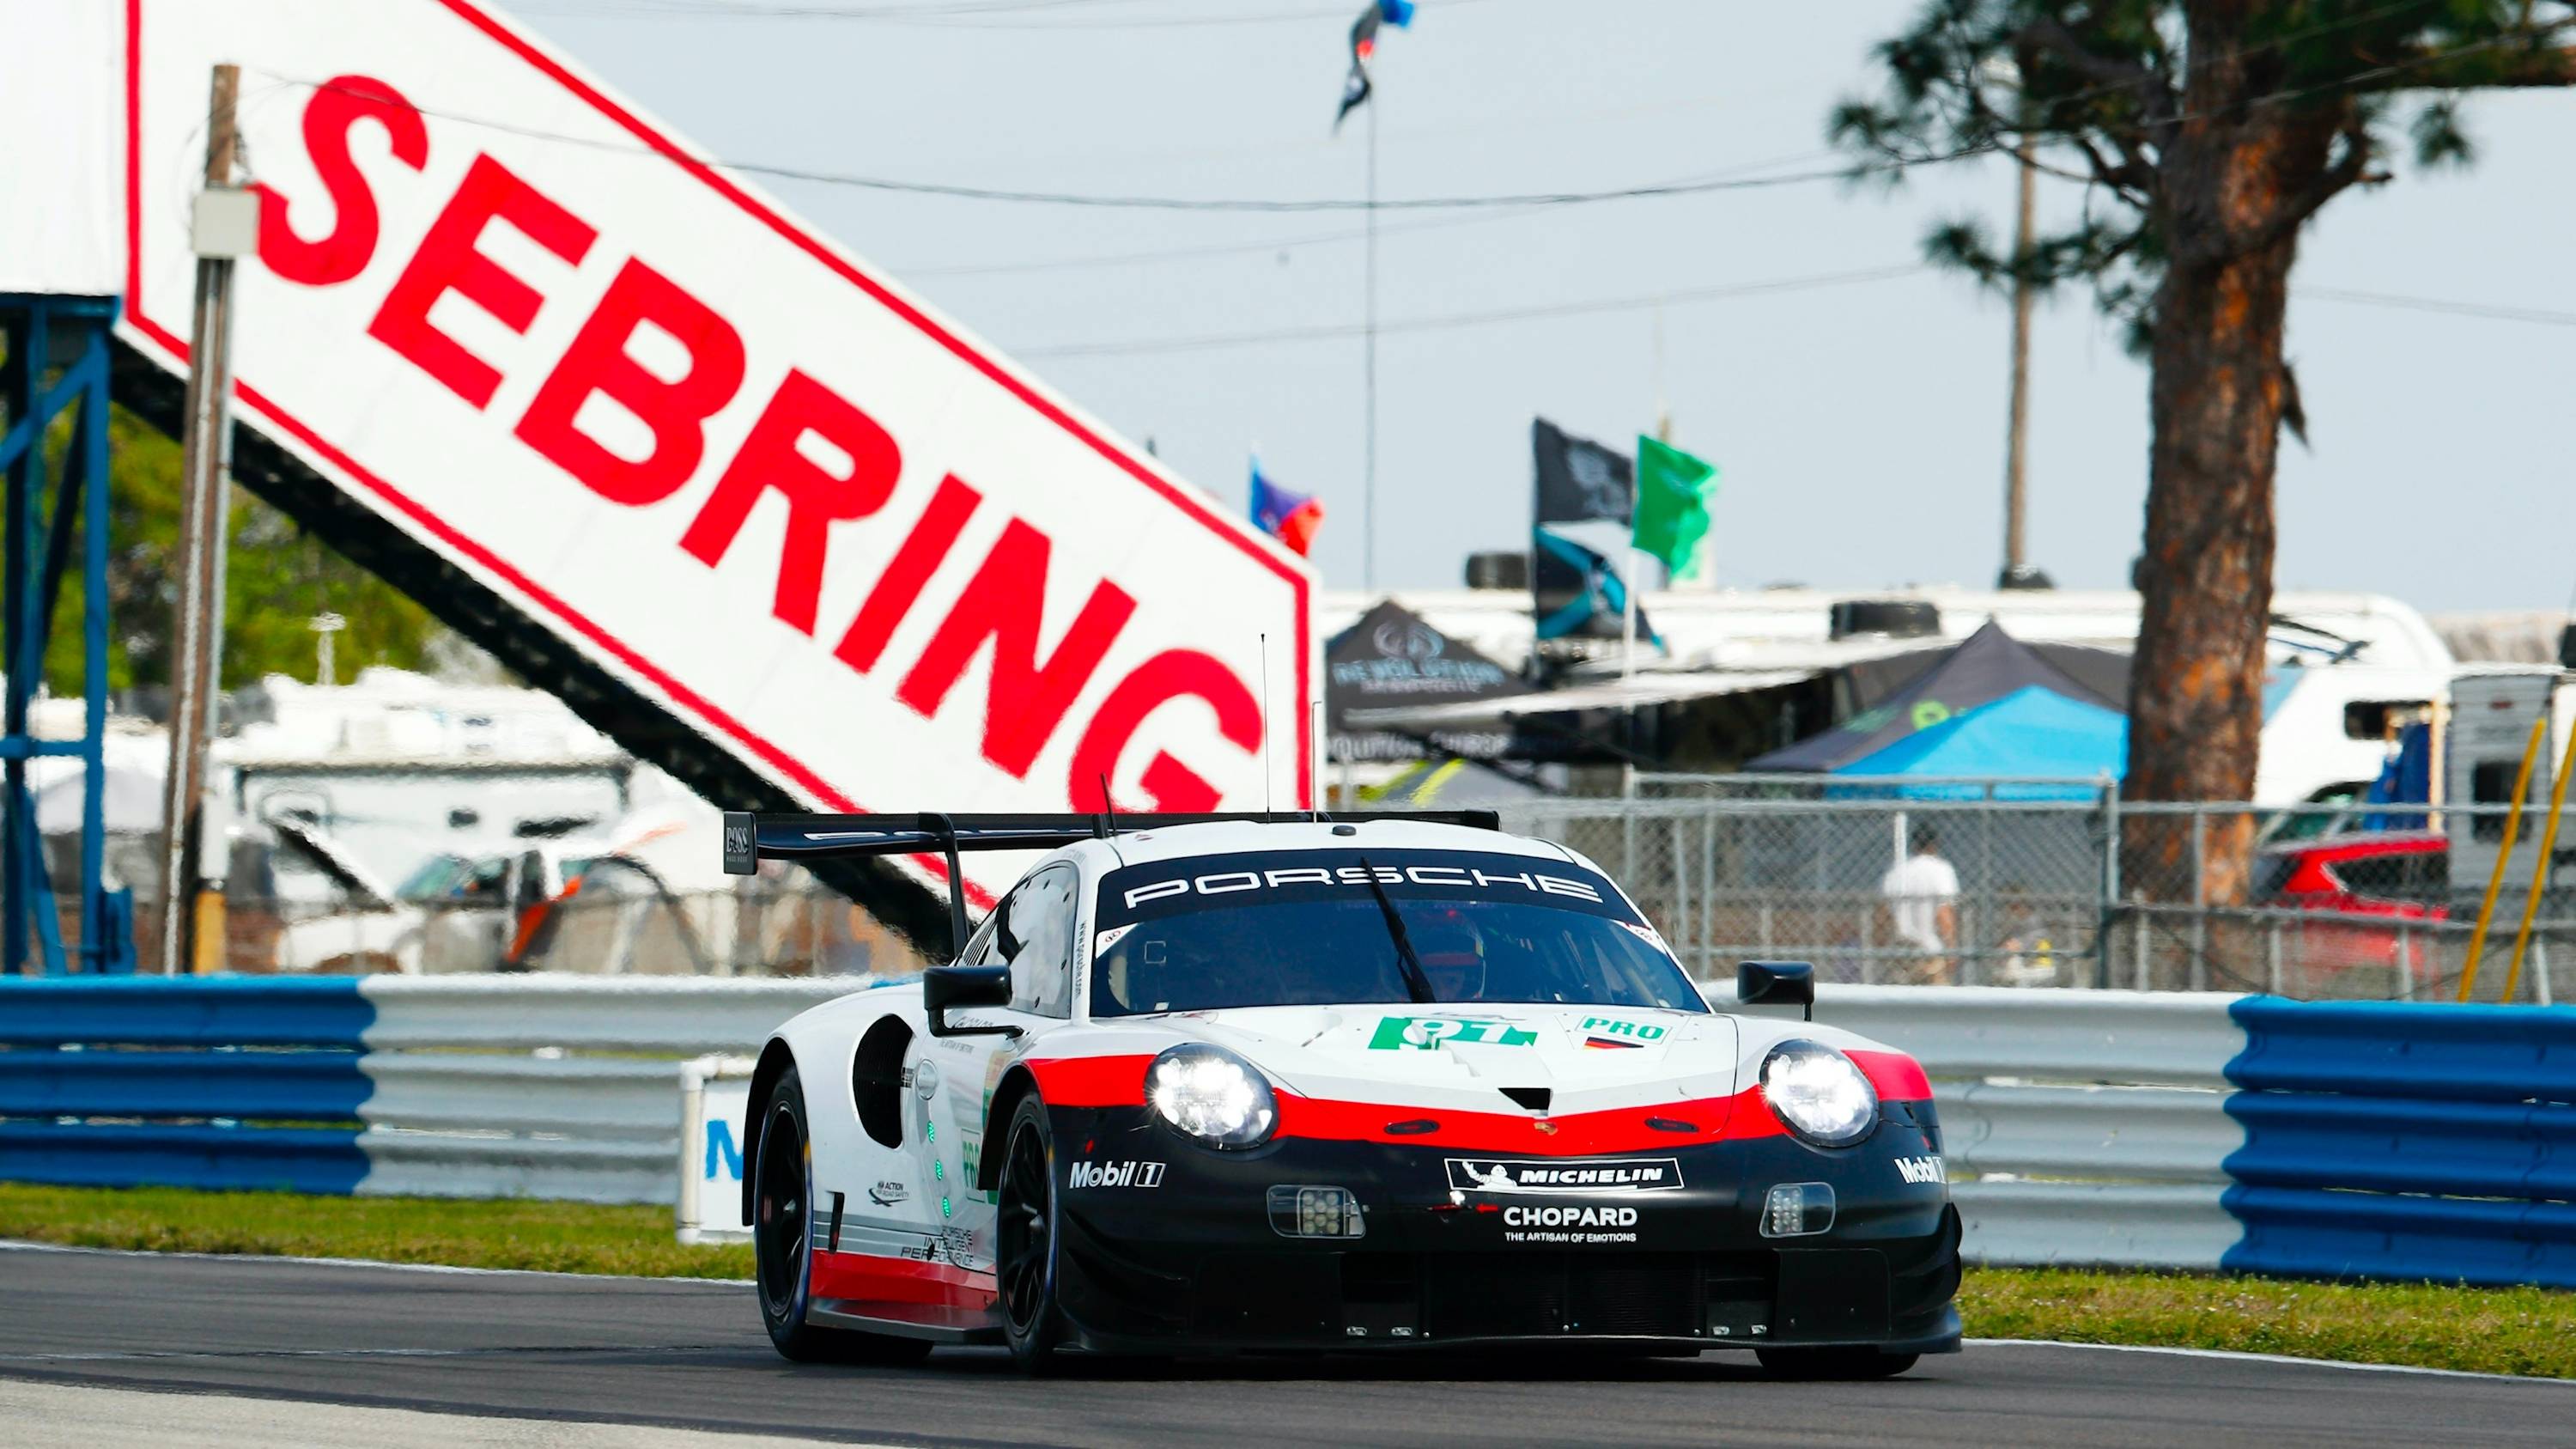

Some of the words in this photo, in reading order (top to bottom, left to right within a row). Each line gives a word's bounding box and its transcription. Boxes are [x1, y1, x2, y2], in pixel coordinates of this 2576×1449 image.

[246, 74, 1264, 813] SEBRING
[726, 827, 749, 853] BOSS
[1124, 866, 1604, 910] PORSCHE
[1583, 1017, 1665, 1039] PRO
[1069, 1160, 1137, 1189] Mobil
[1519, 1168, 1663, 1184] MICHELIN
[1894, 1156, 1940, 1184] Mobil
[1503, 1206, 1638, 1227] CHOPARD
[1504, 1232, 1525, 1241] THE
[1527, 1232, 1569, 1242] ARTISAN
[1571, 1233, 1585, 1243] OF
[1587, 1233, 1637, 1242] EMOTIONS
